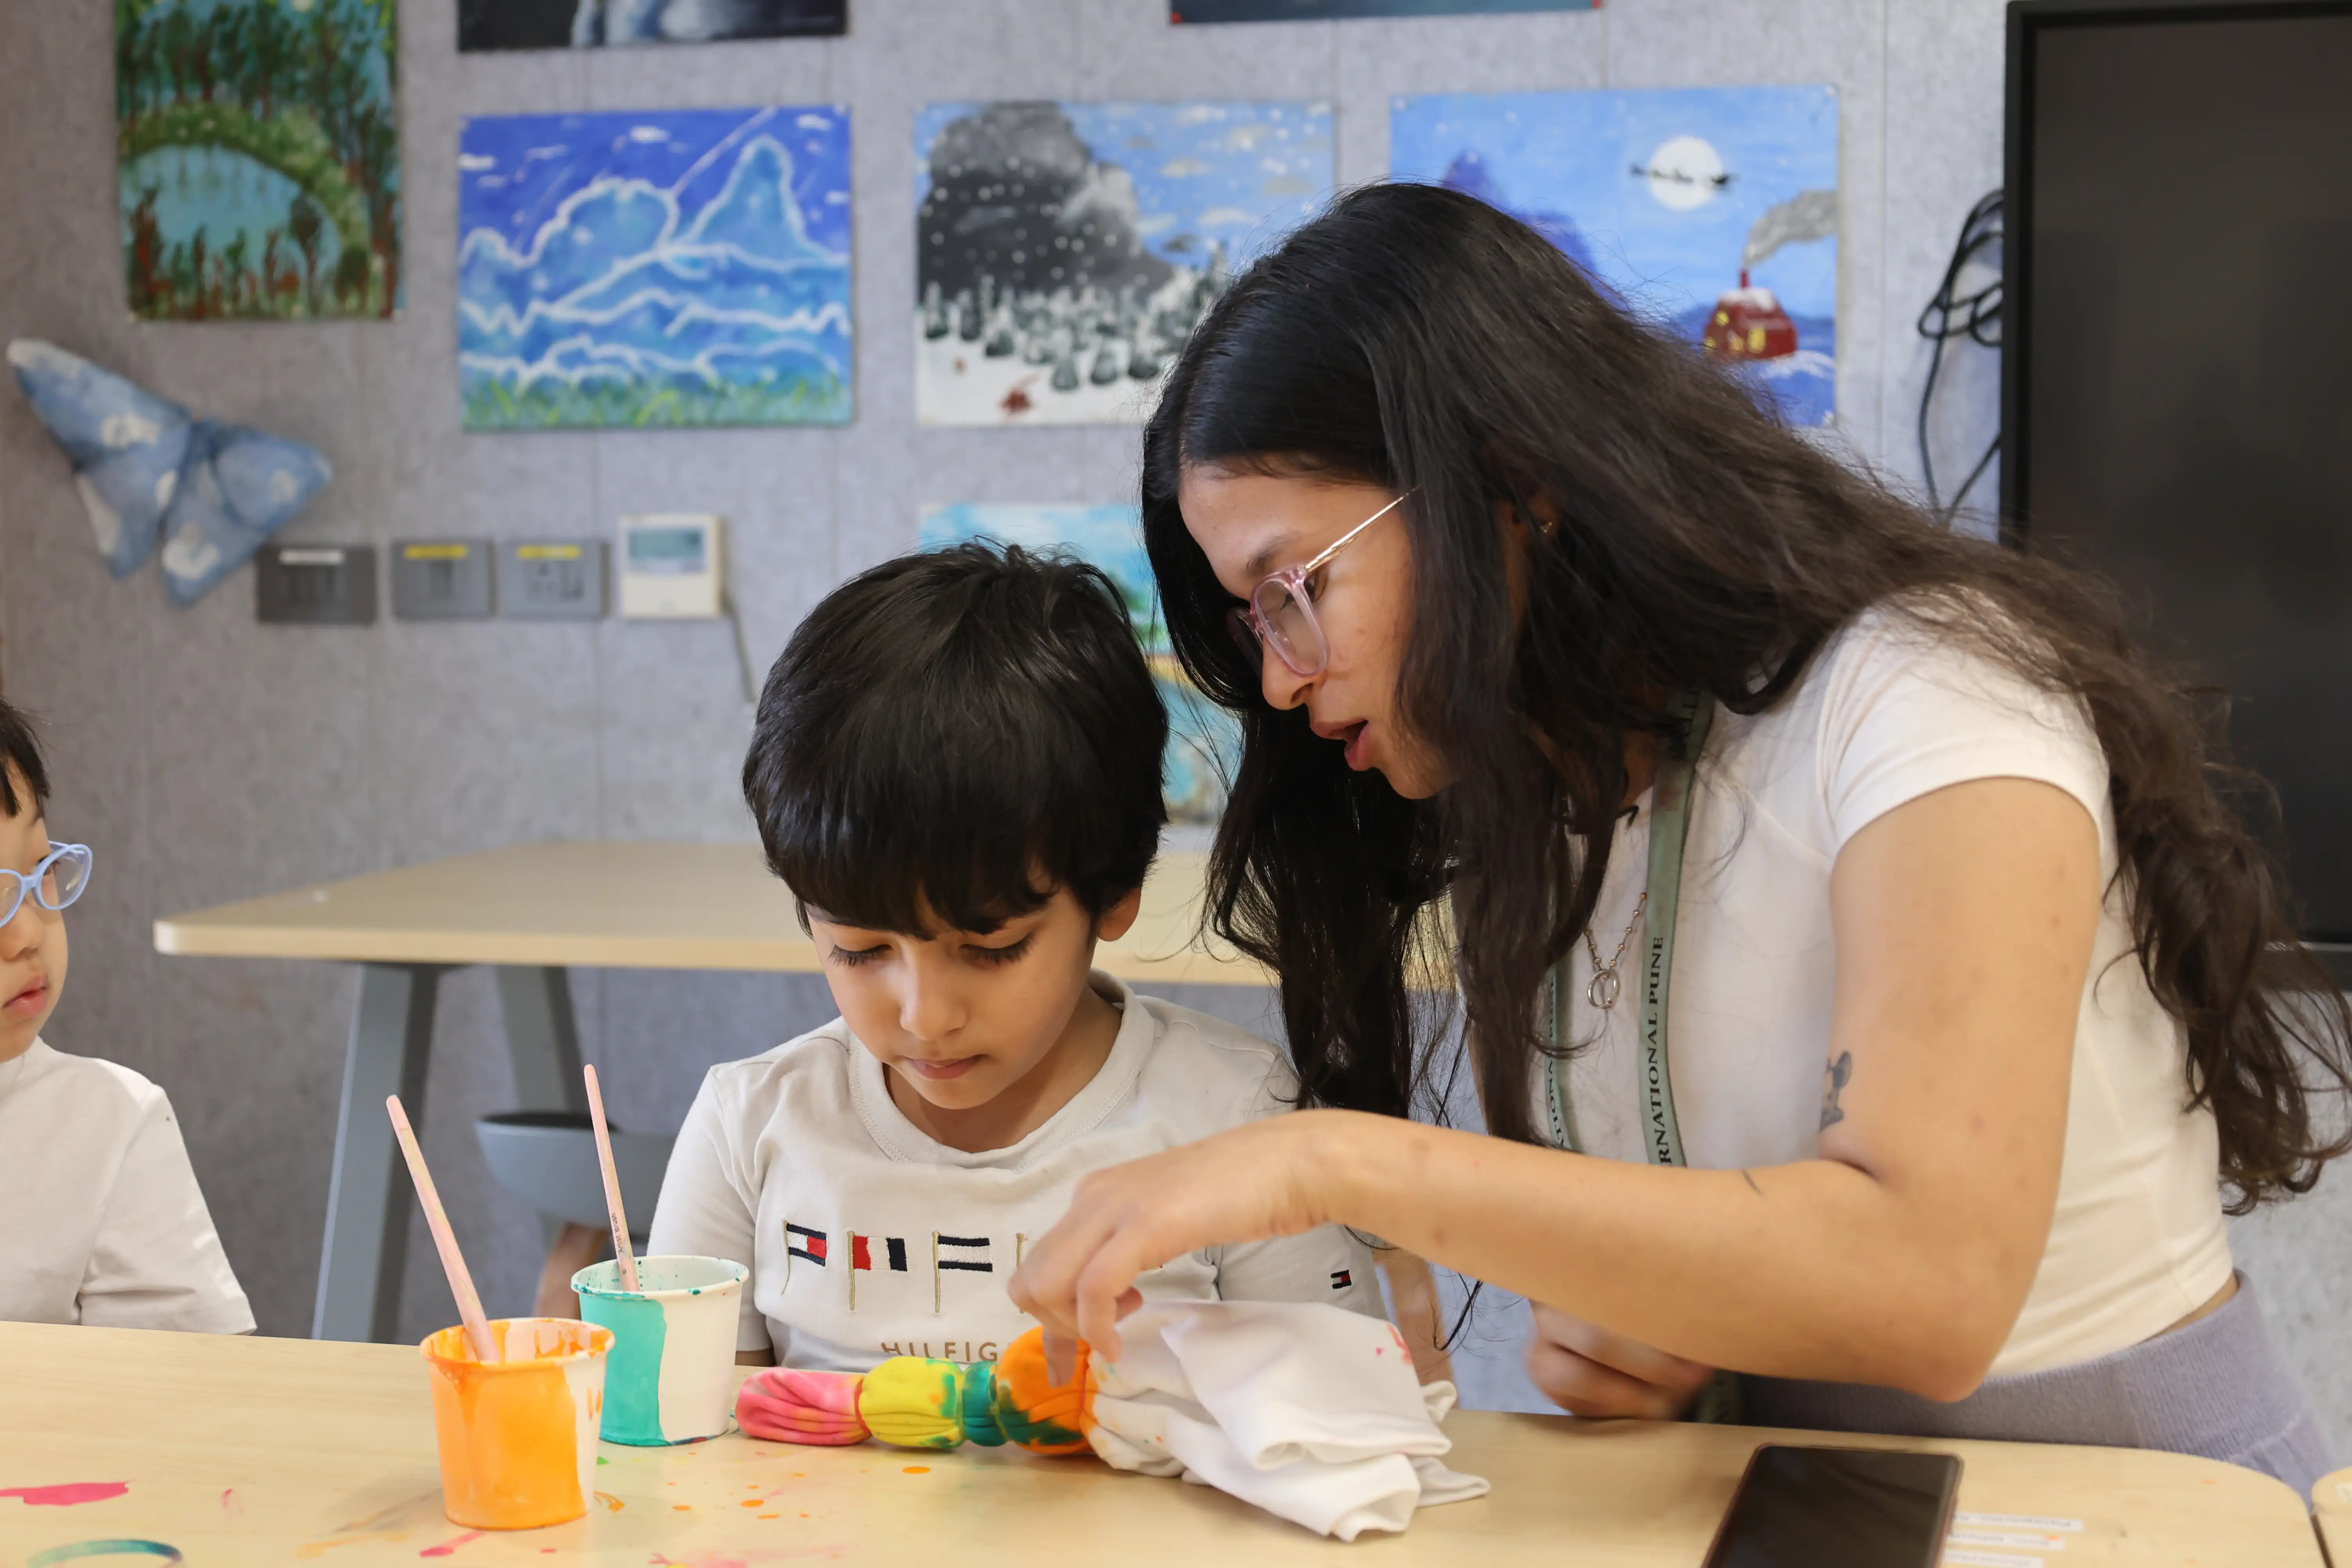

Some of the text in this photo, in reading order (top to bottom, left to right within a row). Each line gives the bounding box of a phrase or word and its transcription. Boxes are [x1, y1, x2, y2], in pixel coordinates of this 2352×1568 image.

[1648, 937, 1673, 1164] RNATIONAL PUNE
[881, 1342, 998, 1363] HILFIG
